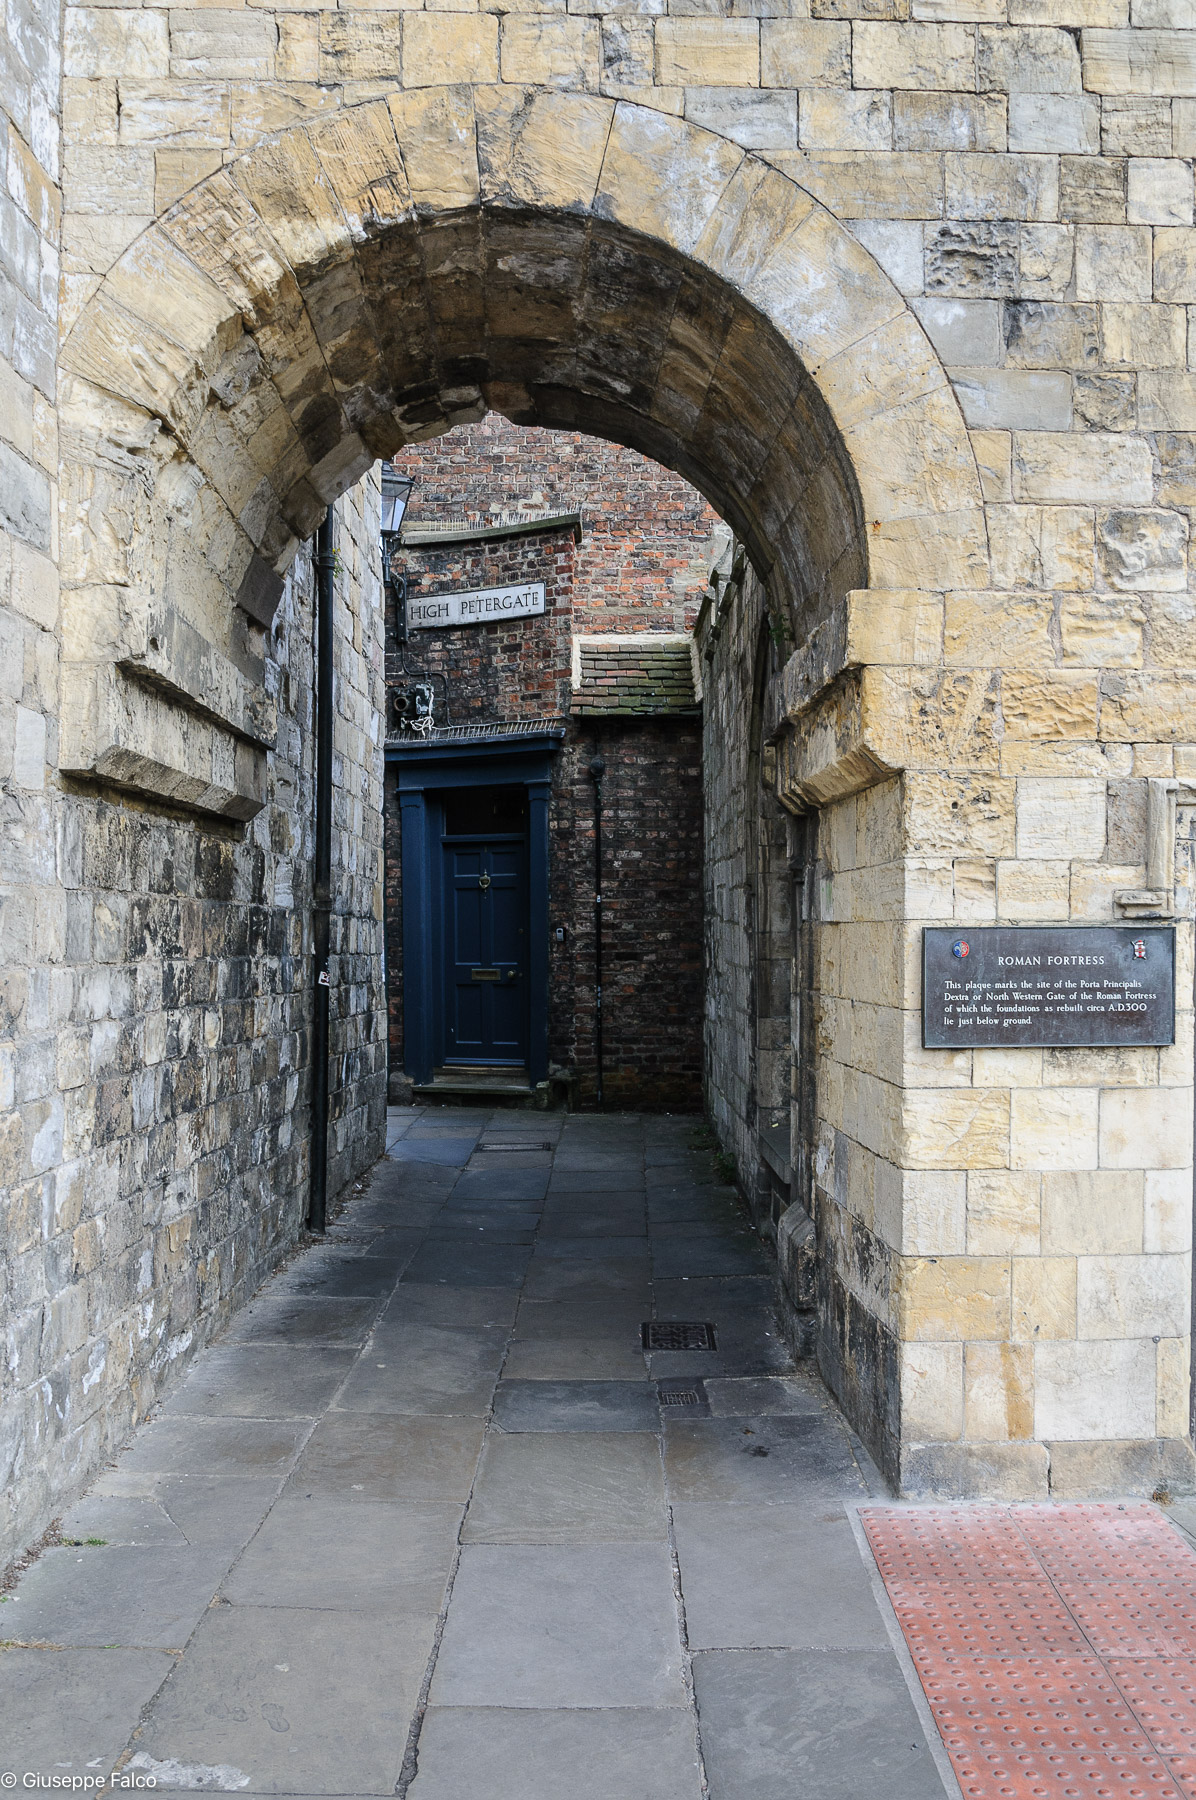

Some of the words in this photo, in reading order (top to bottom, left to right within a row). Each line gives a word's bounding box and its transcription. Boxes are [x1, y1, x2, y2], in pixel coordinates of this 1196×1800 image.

[410, 603, 449, 620] HIGH
[461, 592, 539, 614] PETERGATE
[998, 956, 1041, 965] ROMAN
[1047, 956, 1105, 965] FORTRESS
[945, 981, 961, 989] This
[966, 981, 991, 991] plaque
[1021, 980, 1032, 988] the
[1054, 980, 1062, 988] of
[1065, 980, 1077, 988] the
[1080, 980, 1100, 988] Porta
[1104, 980, 1142, 990] Principalis
[986, 992, 1009, 1000] North
[1012, 992, 1042, 1000] Western
[1047, 992, 1065, 1000] Gate
[1069, 992, 1077, 1000] of
[1096, 992, 1121, 1000] Roman
[1126, 991, 1156, 999] Fortress
[945, 1005, 952, 1013] of
[956, 1004, 978, 1012] which
[981, 1004, 992, 1012] the
[997, 1004, 1040, 1012] foundations
[1057, 1004, 1083, 1012] rebuilt
[1087, 1004, 1105, 1012] circa
[1108, 1003, 1147, 1011] A.D.300
[944, 1017, 954, 1025] lie
[958, 1017, 973, 1027] just
[1003, 1016, 1032, 1027] ground.
